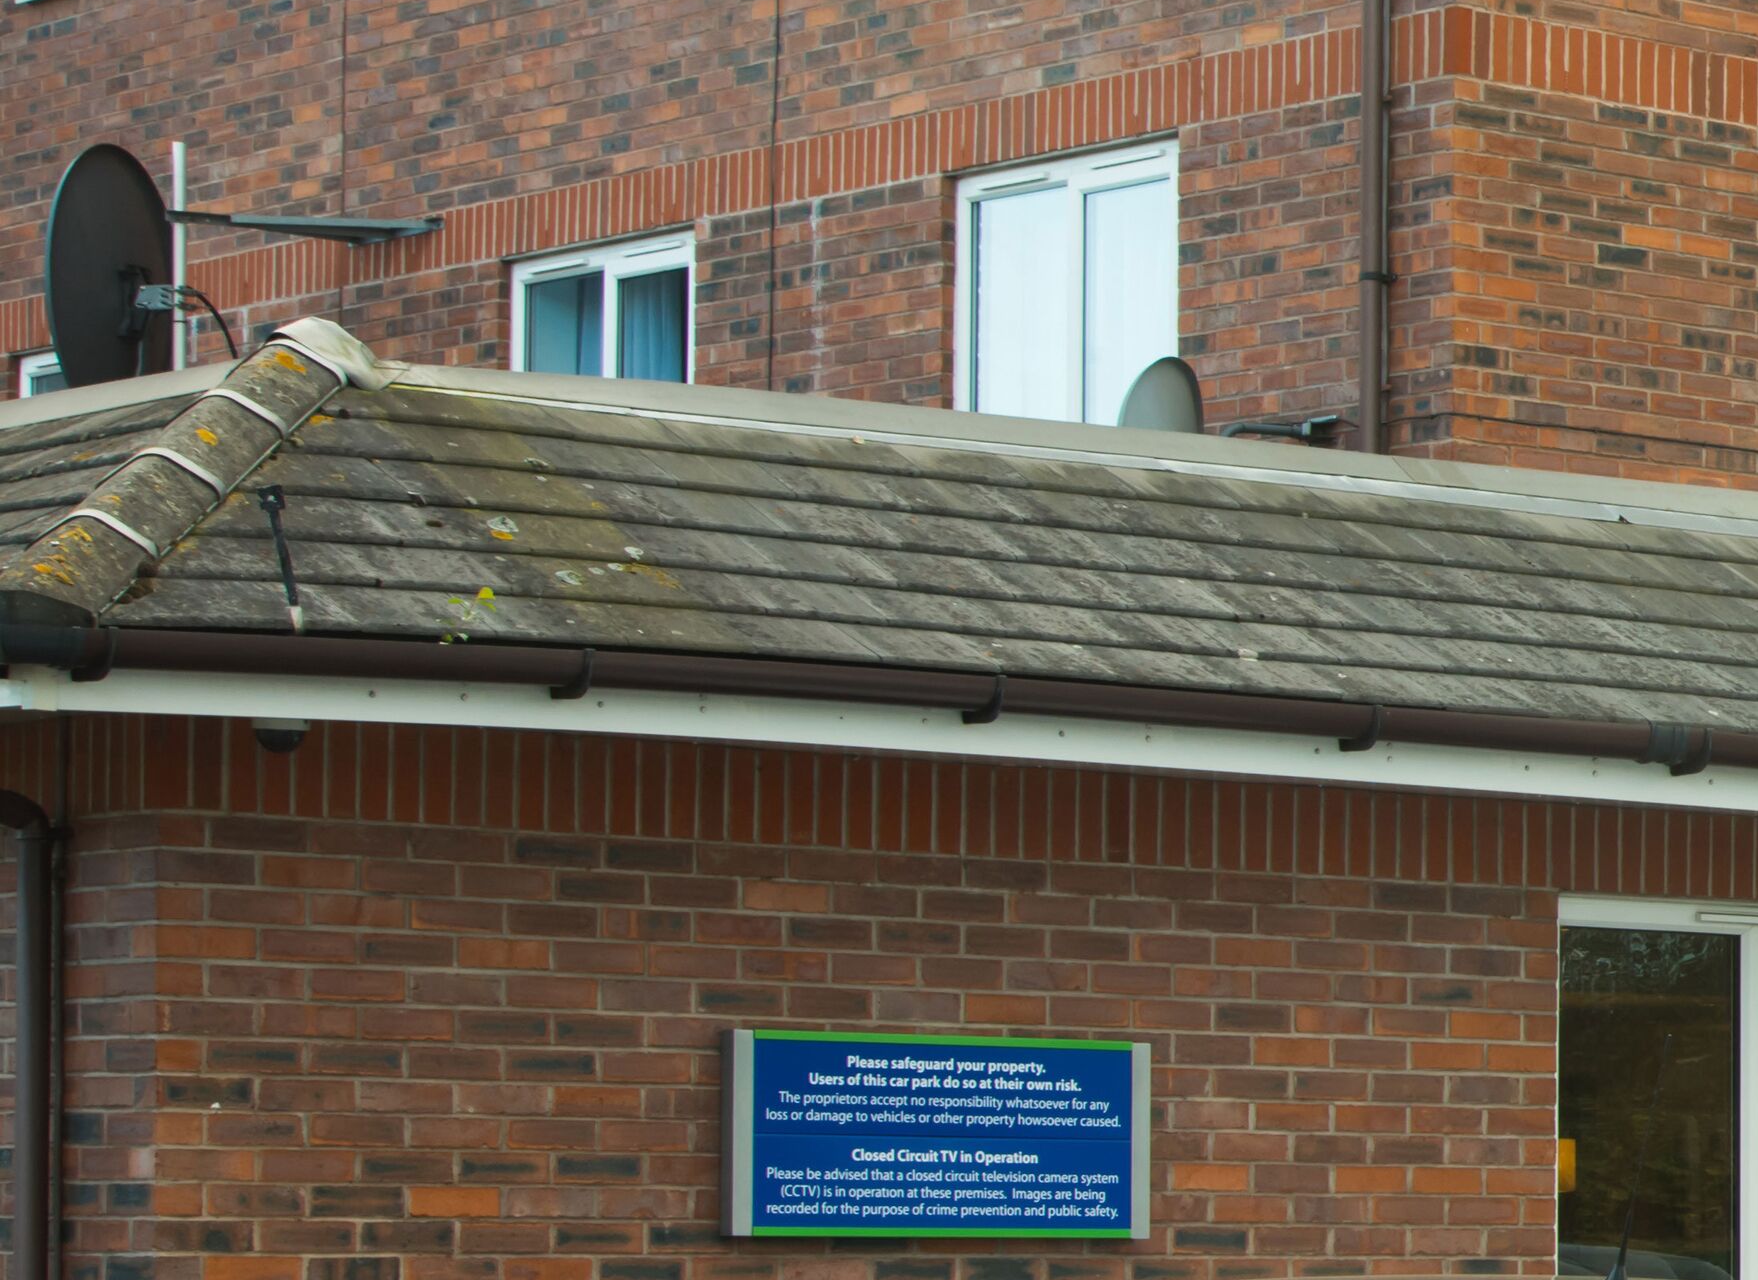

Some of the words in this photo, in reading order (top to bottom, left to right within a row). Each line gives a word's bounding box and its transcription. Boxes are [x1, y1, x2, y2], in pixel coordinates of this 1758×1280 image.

[846, 1056, 889, 1069] Please
[890, 1057, 954, 1073] safeguard
[956, 1061, 986, 1074] your
[987, 1059, 1046, 1075] property.
[808, 1072, 845, 1085] Users
[846, 1073, 861, 1086] of
[862, 1073, 887, 1086] this
[888, 1077, 910, 1087] car
[911, 1075, 941, 1090] park
[942, 1075, 960, 1088] do
[962, 1078, 977, 1089] so
[978, 1076, 992, 1089] at
[993, 1077, 1025, 1090] their
[1026, 1080, 1053, 1090] own
[1055, 1078, 1082, 1091] risk.
[778, 1090, 801, 1103] The
[803, 1091, 868, 1106] proprietors
[869, 1092, 908, 1107] accept
[910, 1095, 926, 1105] no
[928, 1094, 1004, 1109] responsibility
[1005, 1096, 1070, 1108] whatsoever
[1071, 1097, 1088, 1109] for
[1089, 1100, 1110, 1112] any
[765, 1107, 788, 1120] loss
[790, 1110, 803, 1120] or
[805, 1109, 853, 1124] damage
[855, 1109, 868, 1122] to
[870, 1110, 916, 1122] vehicles
[918, 1113, 931, 1123] or
[932, 1111, 964, 1124] other
[966, 1112, 1016, 1127] property
[1017, 1113, 1078, 1126] howsoever
[1079, 1114, 1121, 1127] caused.
[851, 1149, 895, 1161] Closed
[896, 1150, 939, 1162] Circuit
[939, 1150, 958, 1162] TV
[959, 1150, 973, 1163] in
[974, 1151, 1039, 1166] Operation
[766, 1167, 804, 1179] Please
[806, 1167, 822, 1179] be
[823, 1167, 868, 1180] advised
[870, 1168, 894, 1180] that
[896, 1171, 904, 1181] a
[905, 1168, 943, 1181] closed
[944, 1169, 980, 1181] circuit
[981, 1170, 1036, 1182] television
[1037, 1173, 1079, 1183] camera
[1080, 1171, 1119, 1186] system
[780, 1184, 820, 1199] (CCTV)
[823, 1185, 833, 1197] is
[834, 1185, 846, 1197] in
[848, 1185, 904, 1200] operation
[906, 1186, 918, 1198] at
[920, 1186, 952, 1198] these
[953, 1186, 1007, 1201] premises.
[1012, 1187, 1052, 1202] Images
[1054, 1189, 1073, 1199] are
[1074, 1187, 1106, 1202] being
[766, 1201, 819, 1214] recorded
[821, 1202, 838, 1214] for
[840, 1202, 860, 1214] the
[862, 1205, 910, 1217] purpose
[911, 1203, 924, 1215] of
[925, 1203, 958, 1215] crime
[960, 1203, 1022, 1218] prevention
[1023, 1204, 1045, 1216] and
[1047, 1204, 1082, 1219] public
[1084, 1204, 1119, 1219] safety.
